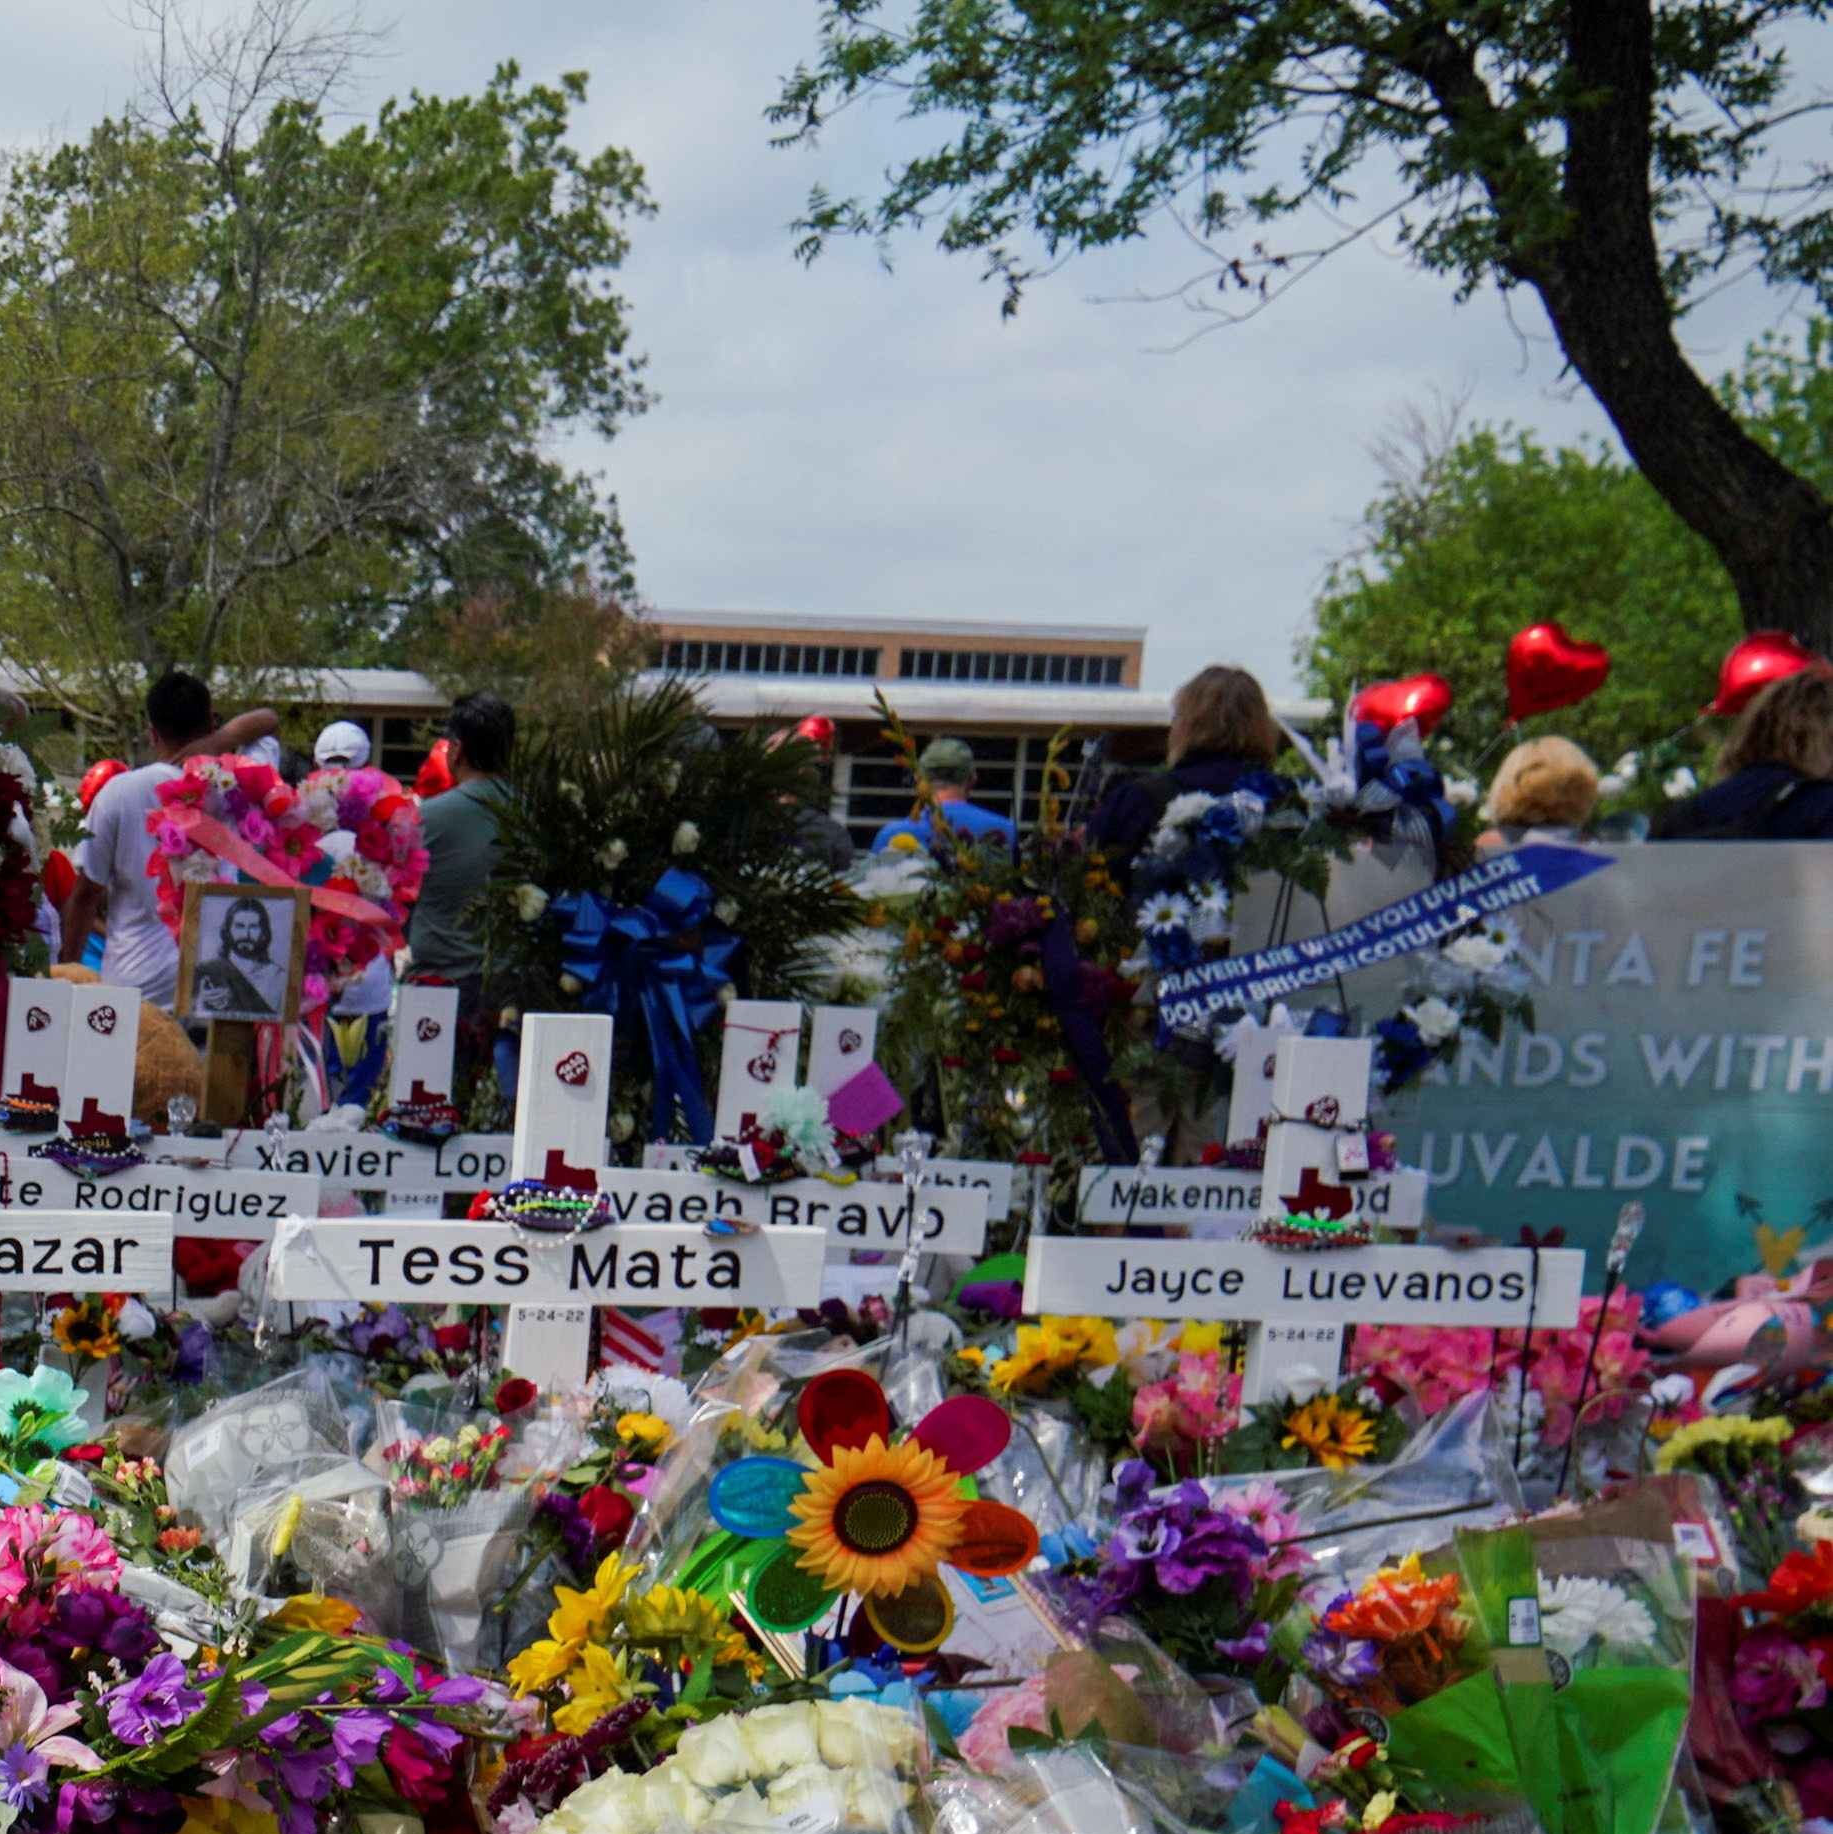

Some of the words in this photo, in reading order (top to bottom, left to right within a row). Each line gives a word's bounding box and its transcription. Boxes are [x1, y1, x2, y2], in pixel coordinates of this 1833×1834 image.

[1157, 955, 1250, 997] PRAYERS
[1255, 947, 1299, 972] ARE
[1300, 925, 1364, 958] WITH
[1368, 904, 1420, 934] YOU
[1423, 854, 1521, 910] UVALDE
[1161, 986, 1245, 1028] DOLPH
[1481, 874, 1542, 912] UNIT
[1687, 930, 1768, 986] FE
[1639, 1034, 1833, 1092] WITH
[257, 1144, 403, 1177] Xavier
[435, 1146, 513, 1181] Lop
[1419, 1132, 1710, 1192] UVALDE
[76, 1178, 289, 1221] Rodriguez
[770, 1194, 945, 1239] Bravo
[359, 1239, 531, 1286] Tess
[569, 1242, 742, 1290] Mata
[1106, 1259, 1246, 1303] Jayce
[1283, 1266, 1524, 1302] Luevanos
[517, 1309, 585, 1322] 5-24-22
